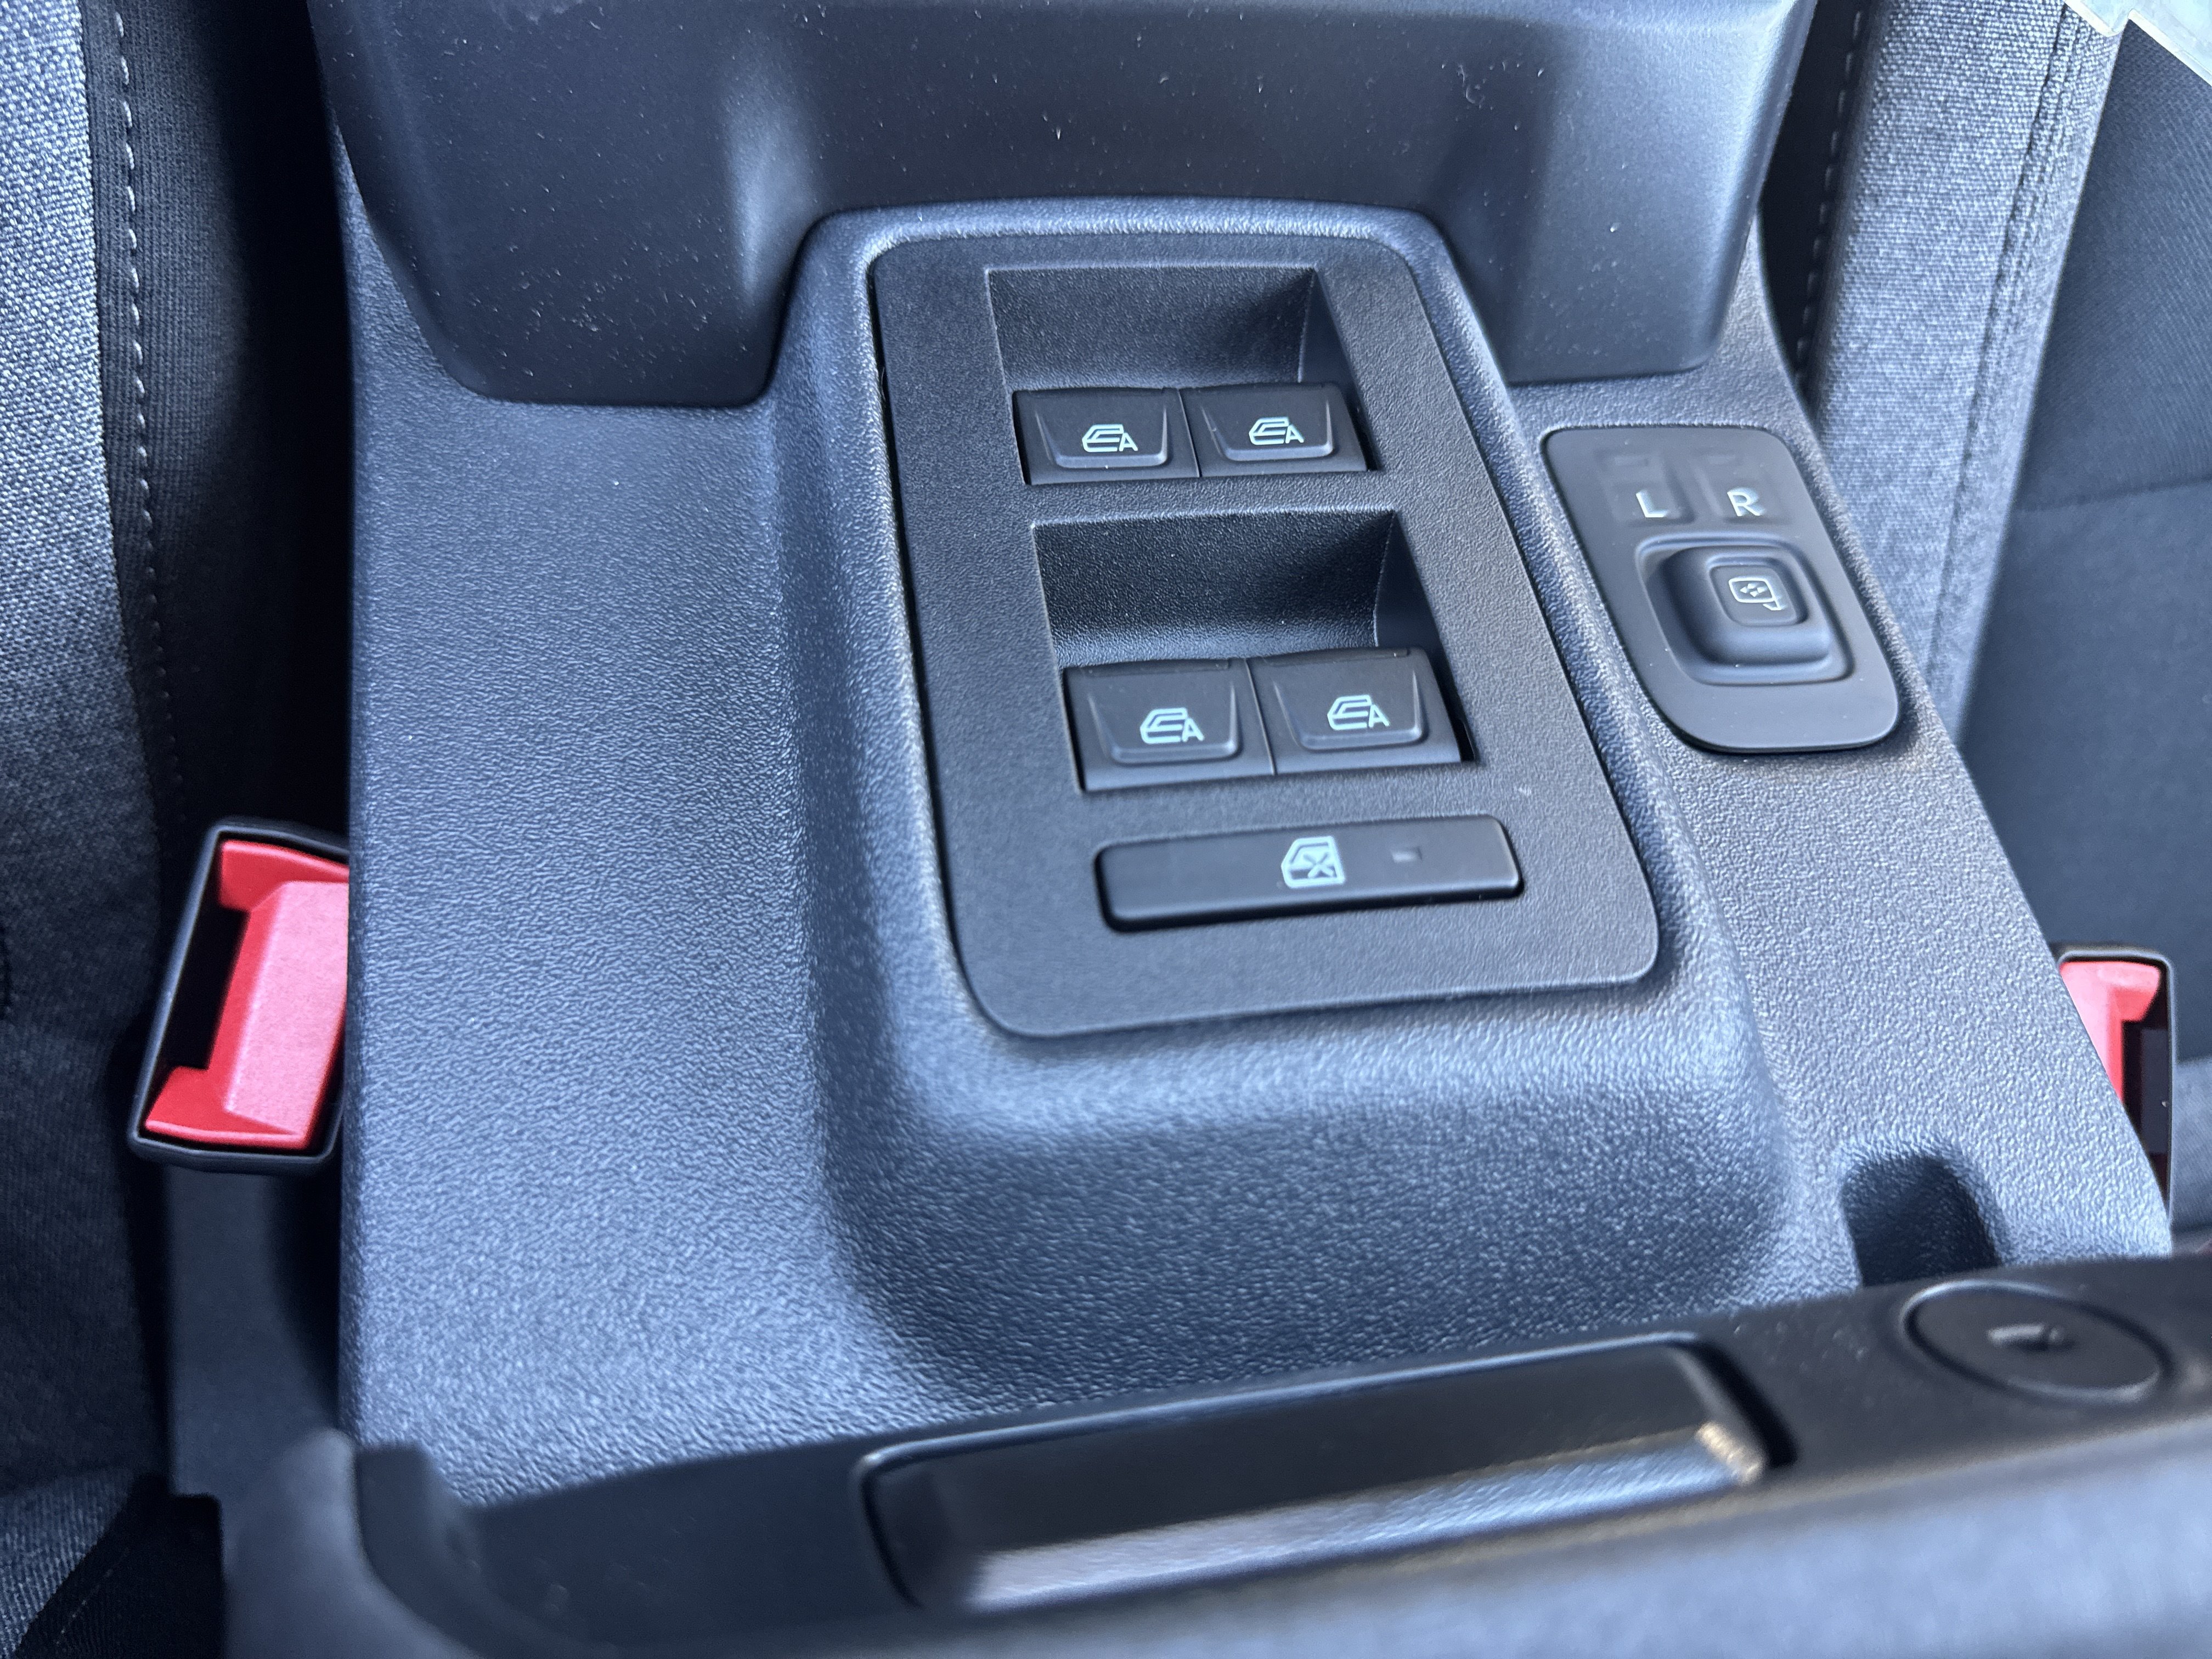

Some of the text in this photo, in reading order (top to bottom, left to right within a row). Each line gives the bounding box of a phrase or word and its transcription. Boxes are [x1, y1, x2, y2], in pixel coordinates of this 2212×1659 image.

[1119, 433, 1138, 452] A
[1285, 425, 1304, 444] A
[1636, 491, 1667, 518] L
[1727, 490, 1764, 516] R
[1368, 704, 1390, 727] A
[1182, 718, 1204, 742] A
